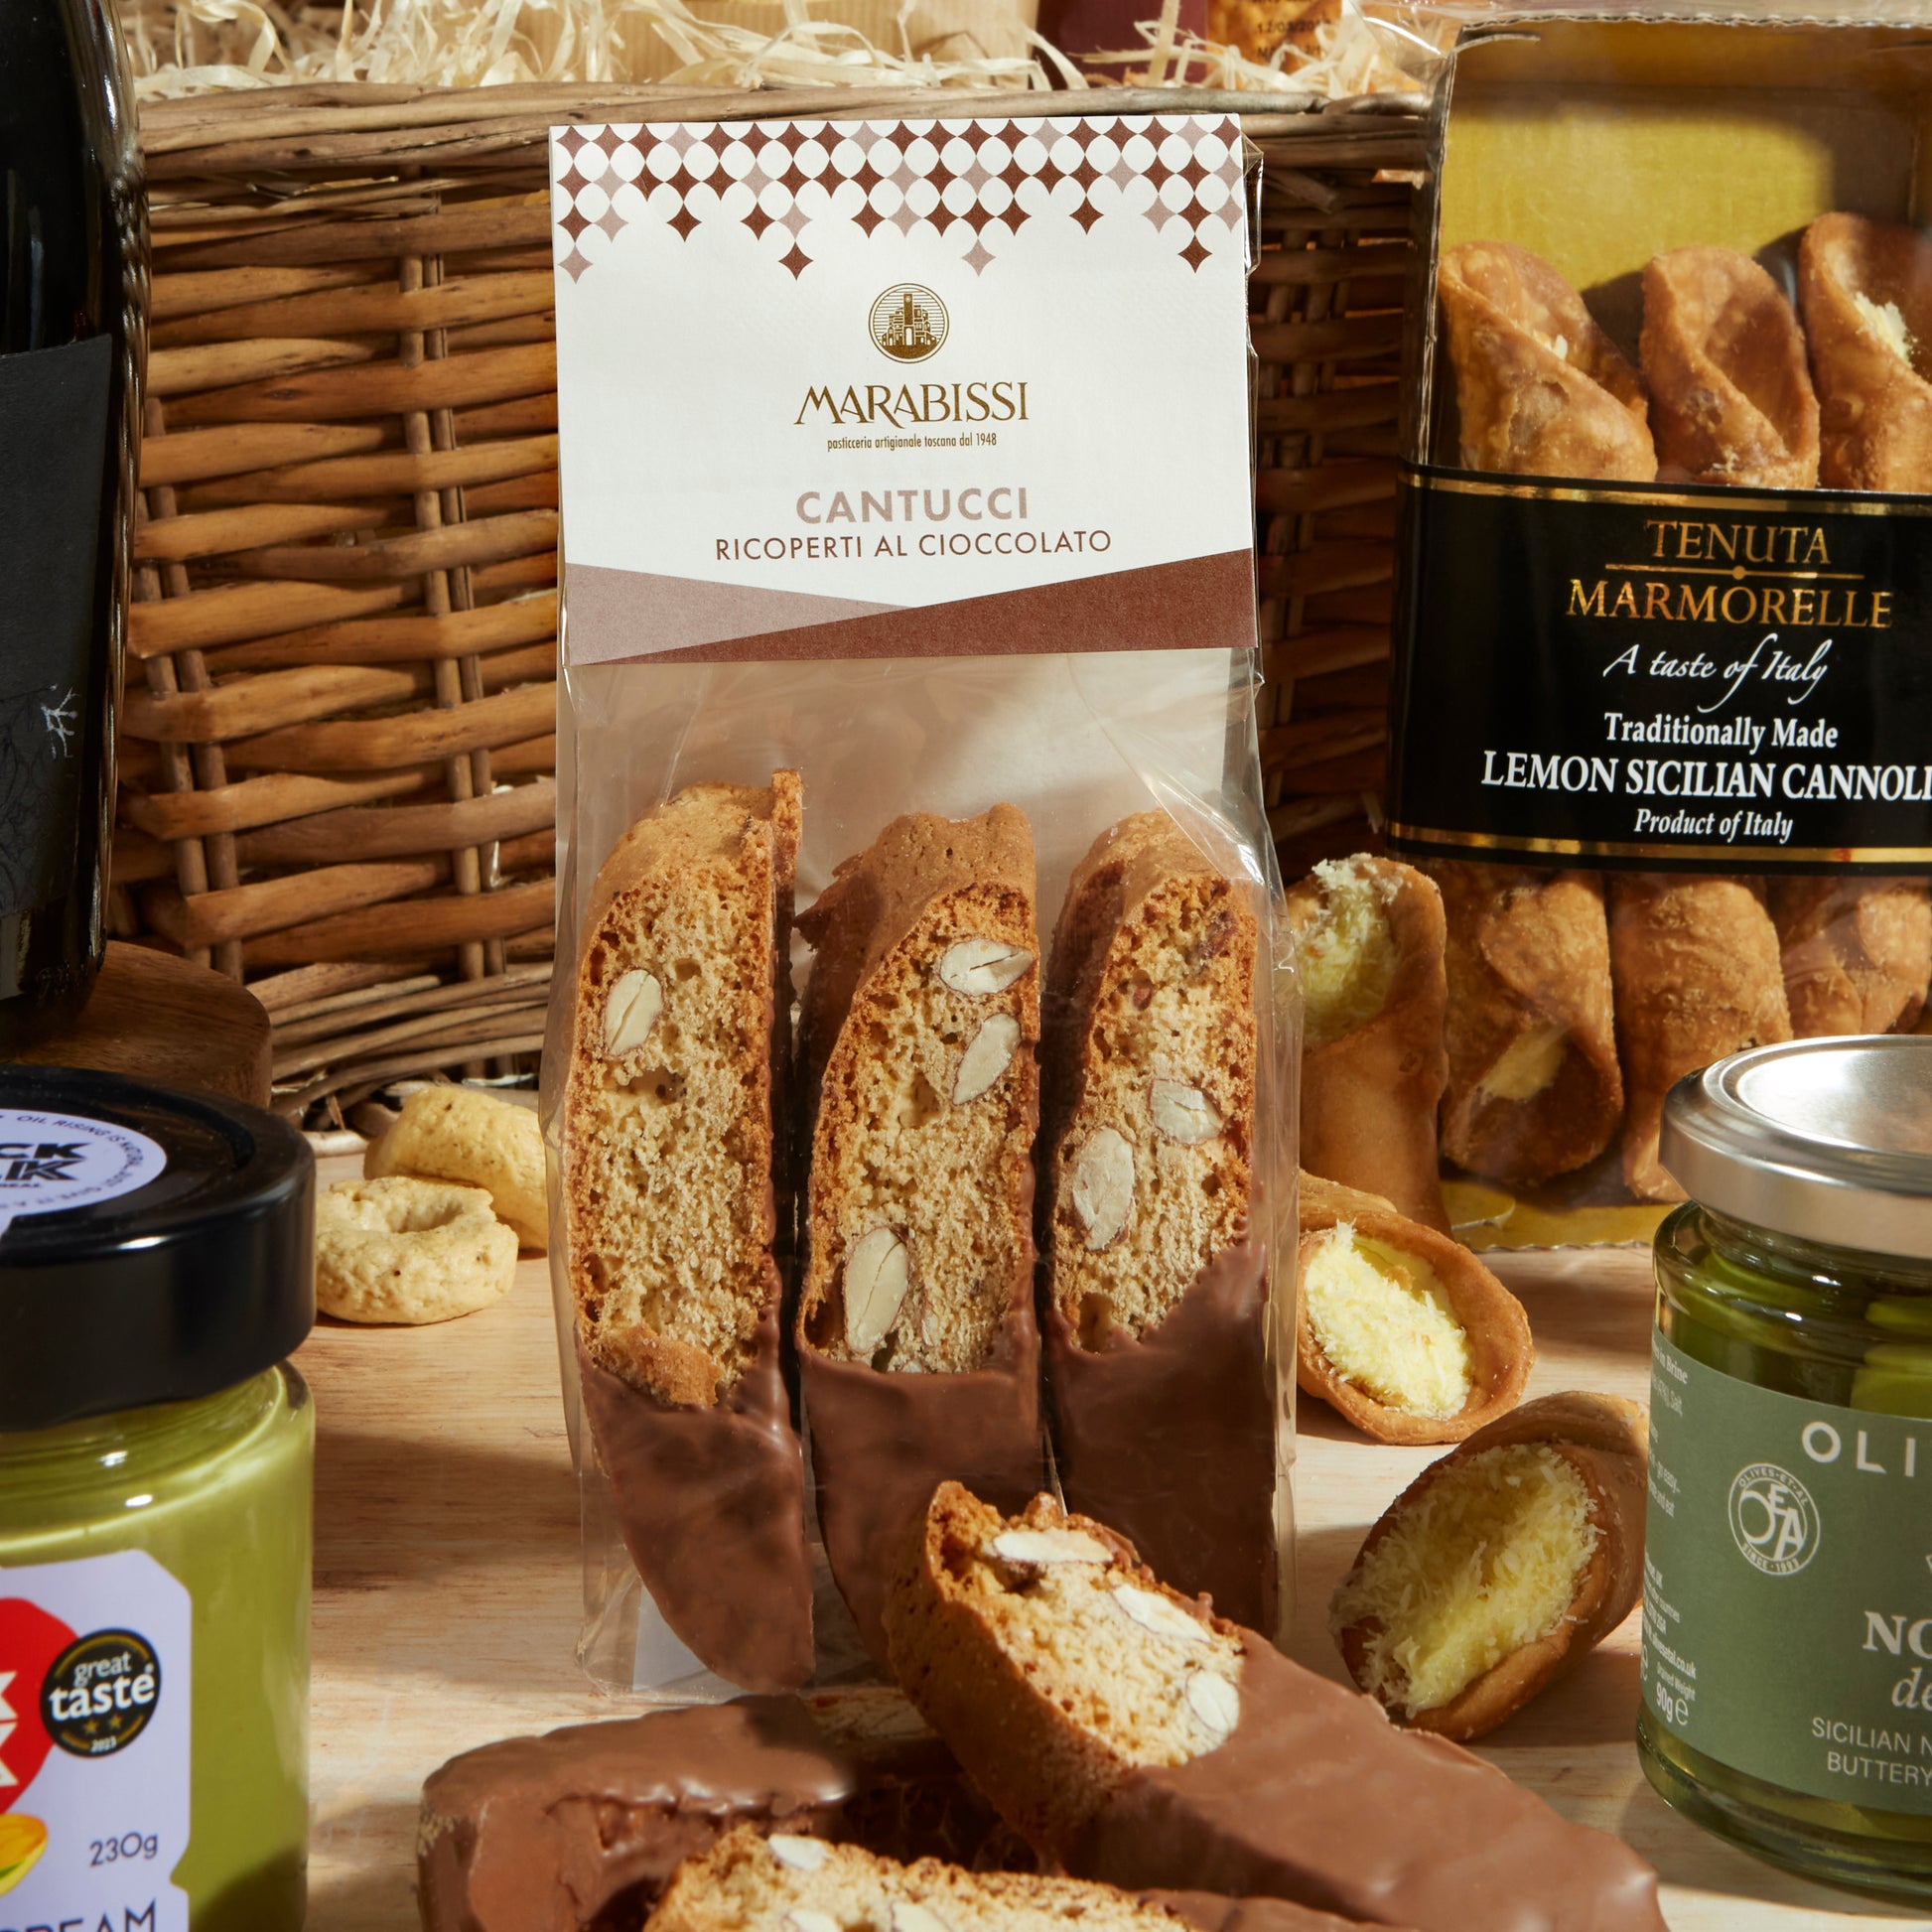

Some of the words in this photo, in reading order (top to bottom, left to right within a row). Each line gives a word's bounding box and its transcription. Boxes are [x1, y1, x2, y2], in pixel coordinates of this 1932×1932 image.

[793, 381, 1030, 429] MARABISSI
[827, 436, 872, 452] pasticceria
[874, 435, 922, 451] artigianale
[924, 435, 957, 448] toscana
[960, 434, 973, 447] dal
[976, 433, 997, 447] 1948
[796, 487, 1029, 524] CANTUCCI
[716, 537, 863, 561] RICOPERTI
[874, 534, 910, 558] AL
[918, 529, 1111, 557] CIOCCOLATO
[1646, 519, 1831, 565] TENUTA
[1566, 579, 1893, 628] MARMORELLE
[1603, 644, 1639, 678] A
[1649, 651, 1717, 679] taste
[1697, 633, 1779, 713] of
[1761, 638, 1834, 705] Italy
[1604, 713, 1766, 756] Traditionally
[1772, 719, 1839, 750] Made
[1481, 751, 1616, 792] LEMON
[1626, 760, 1775, 799] SICILIAN
[1782, 763, 1932, 801] CANNOLI
[1634, 808, 1716, 836] Product
[1719, 811, 1743, 840] of
[1743, 811, 1793, 845] Italy
[1666, 1354, 1688, 1385] Brine
[1802, 1421, 1916, 1477] OLI
[73, 1651, 132, 1688] great
[49, 1671, 155, 1722] taste
[1656, 1682, 1673, 1723] 90g
[1812, 1717, 1910, 1755] SICILIAN
[1828, 1752, 1932, 1787] BUTTERY
[89, 1831, 158, 1867] 230g
